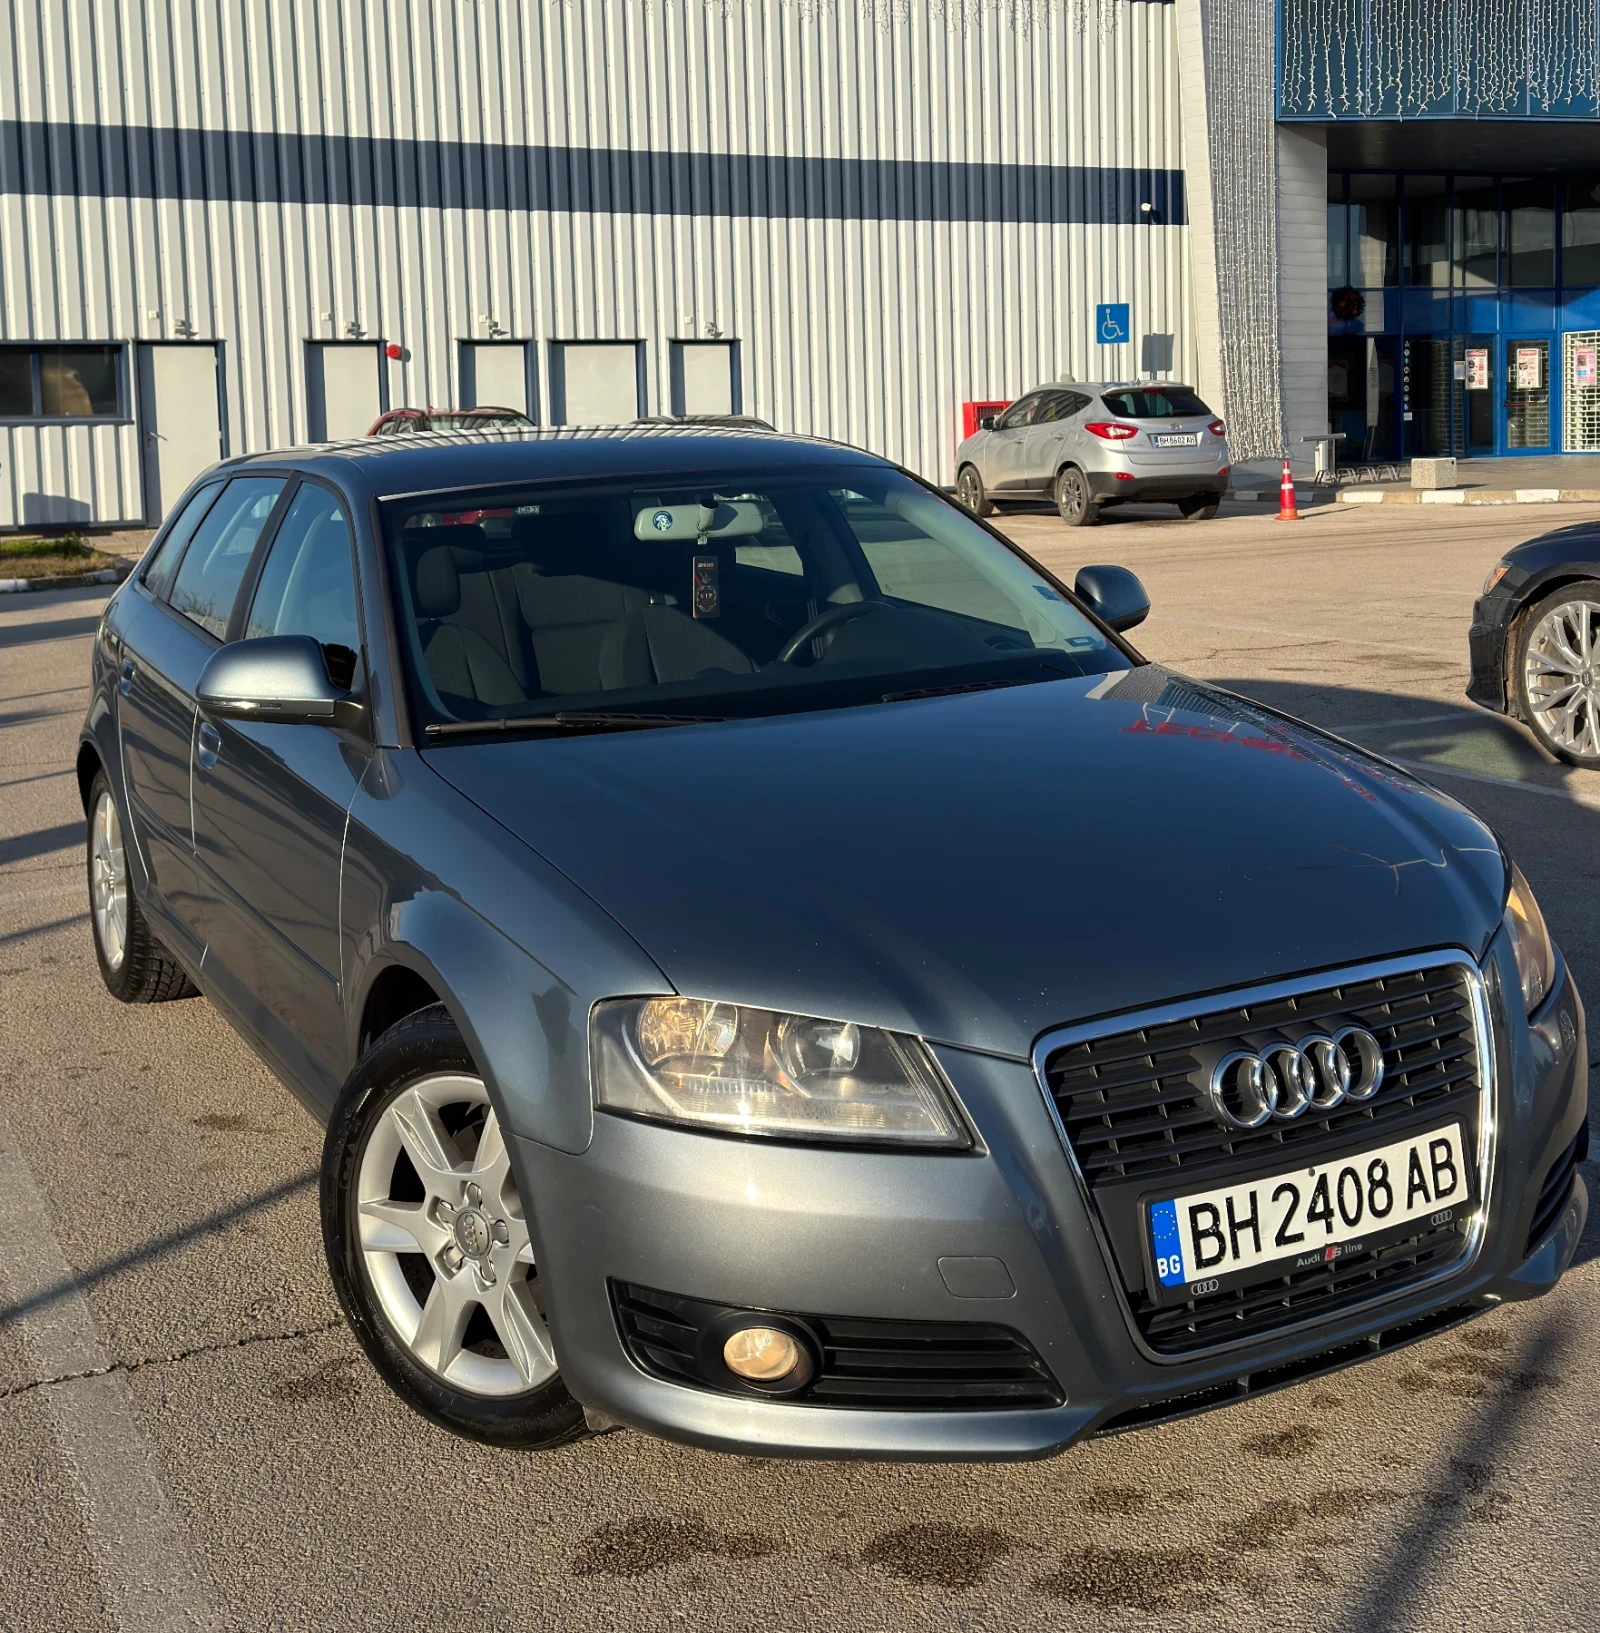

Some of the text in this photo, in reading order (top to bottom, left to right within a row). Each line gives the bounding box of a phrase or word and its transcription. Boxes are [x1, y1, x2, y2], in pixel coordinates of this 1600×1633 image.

[1188, 1137, 1459, 1271] BH 2408 AB
[1157, 1255, 1181, 1278] BG
[1296, 1253, 1321, 1268] Audi
[1345, 1243, 1363, 1254] line
